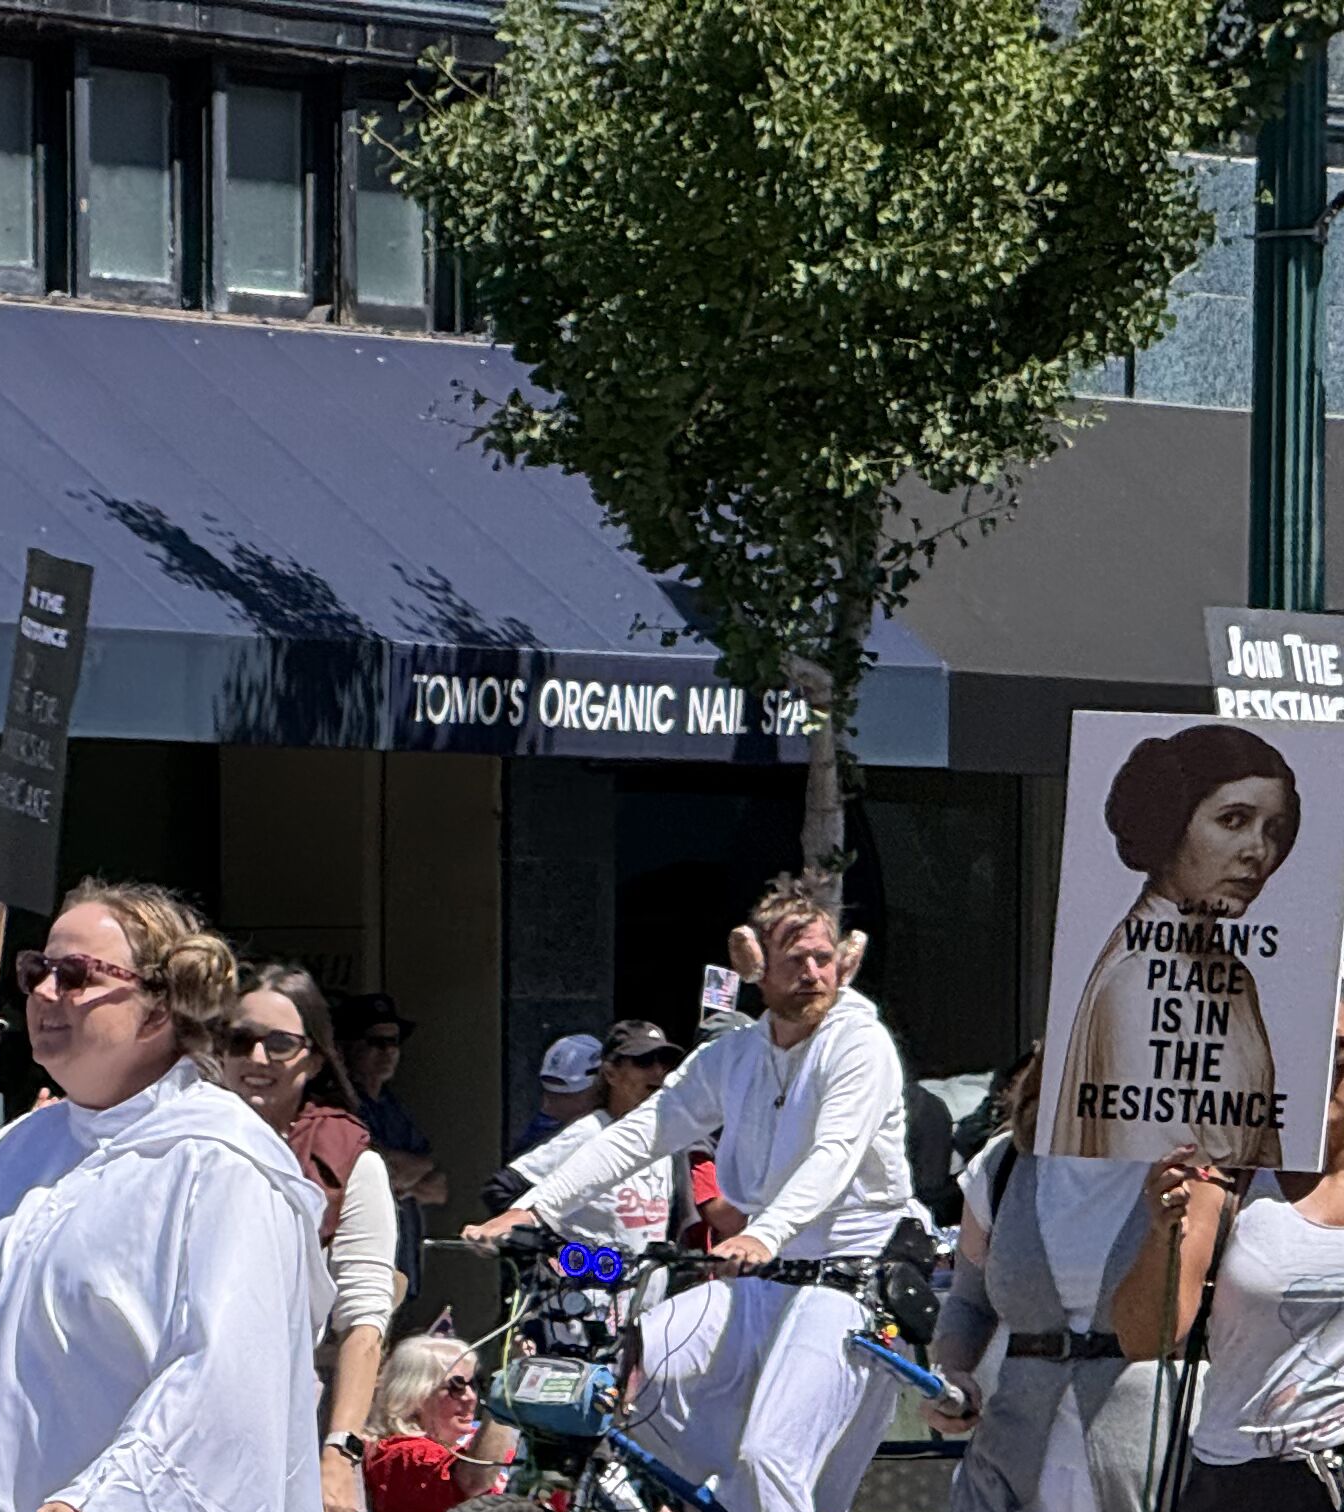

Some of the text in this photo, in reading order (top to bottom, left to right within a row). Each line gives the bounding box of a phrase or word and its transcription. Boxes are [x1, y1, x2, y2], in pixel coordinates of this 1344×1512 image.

[1227, 625, 1344, 686] JOIN THE
[411, 673, 808, 736] TOMO'S ORGANIC NAIL SPA
[1125, 919, 1279, 957] WOMAN'S
[1147, 959, 1246, 995] PLACE
[1150, 998, 1230, 1036] IS IN
[1149, 1040, 1225, 1082] THE
[1076, 1083, 1288, 1129] RESISTANCE
